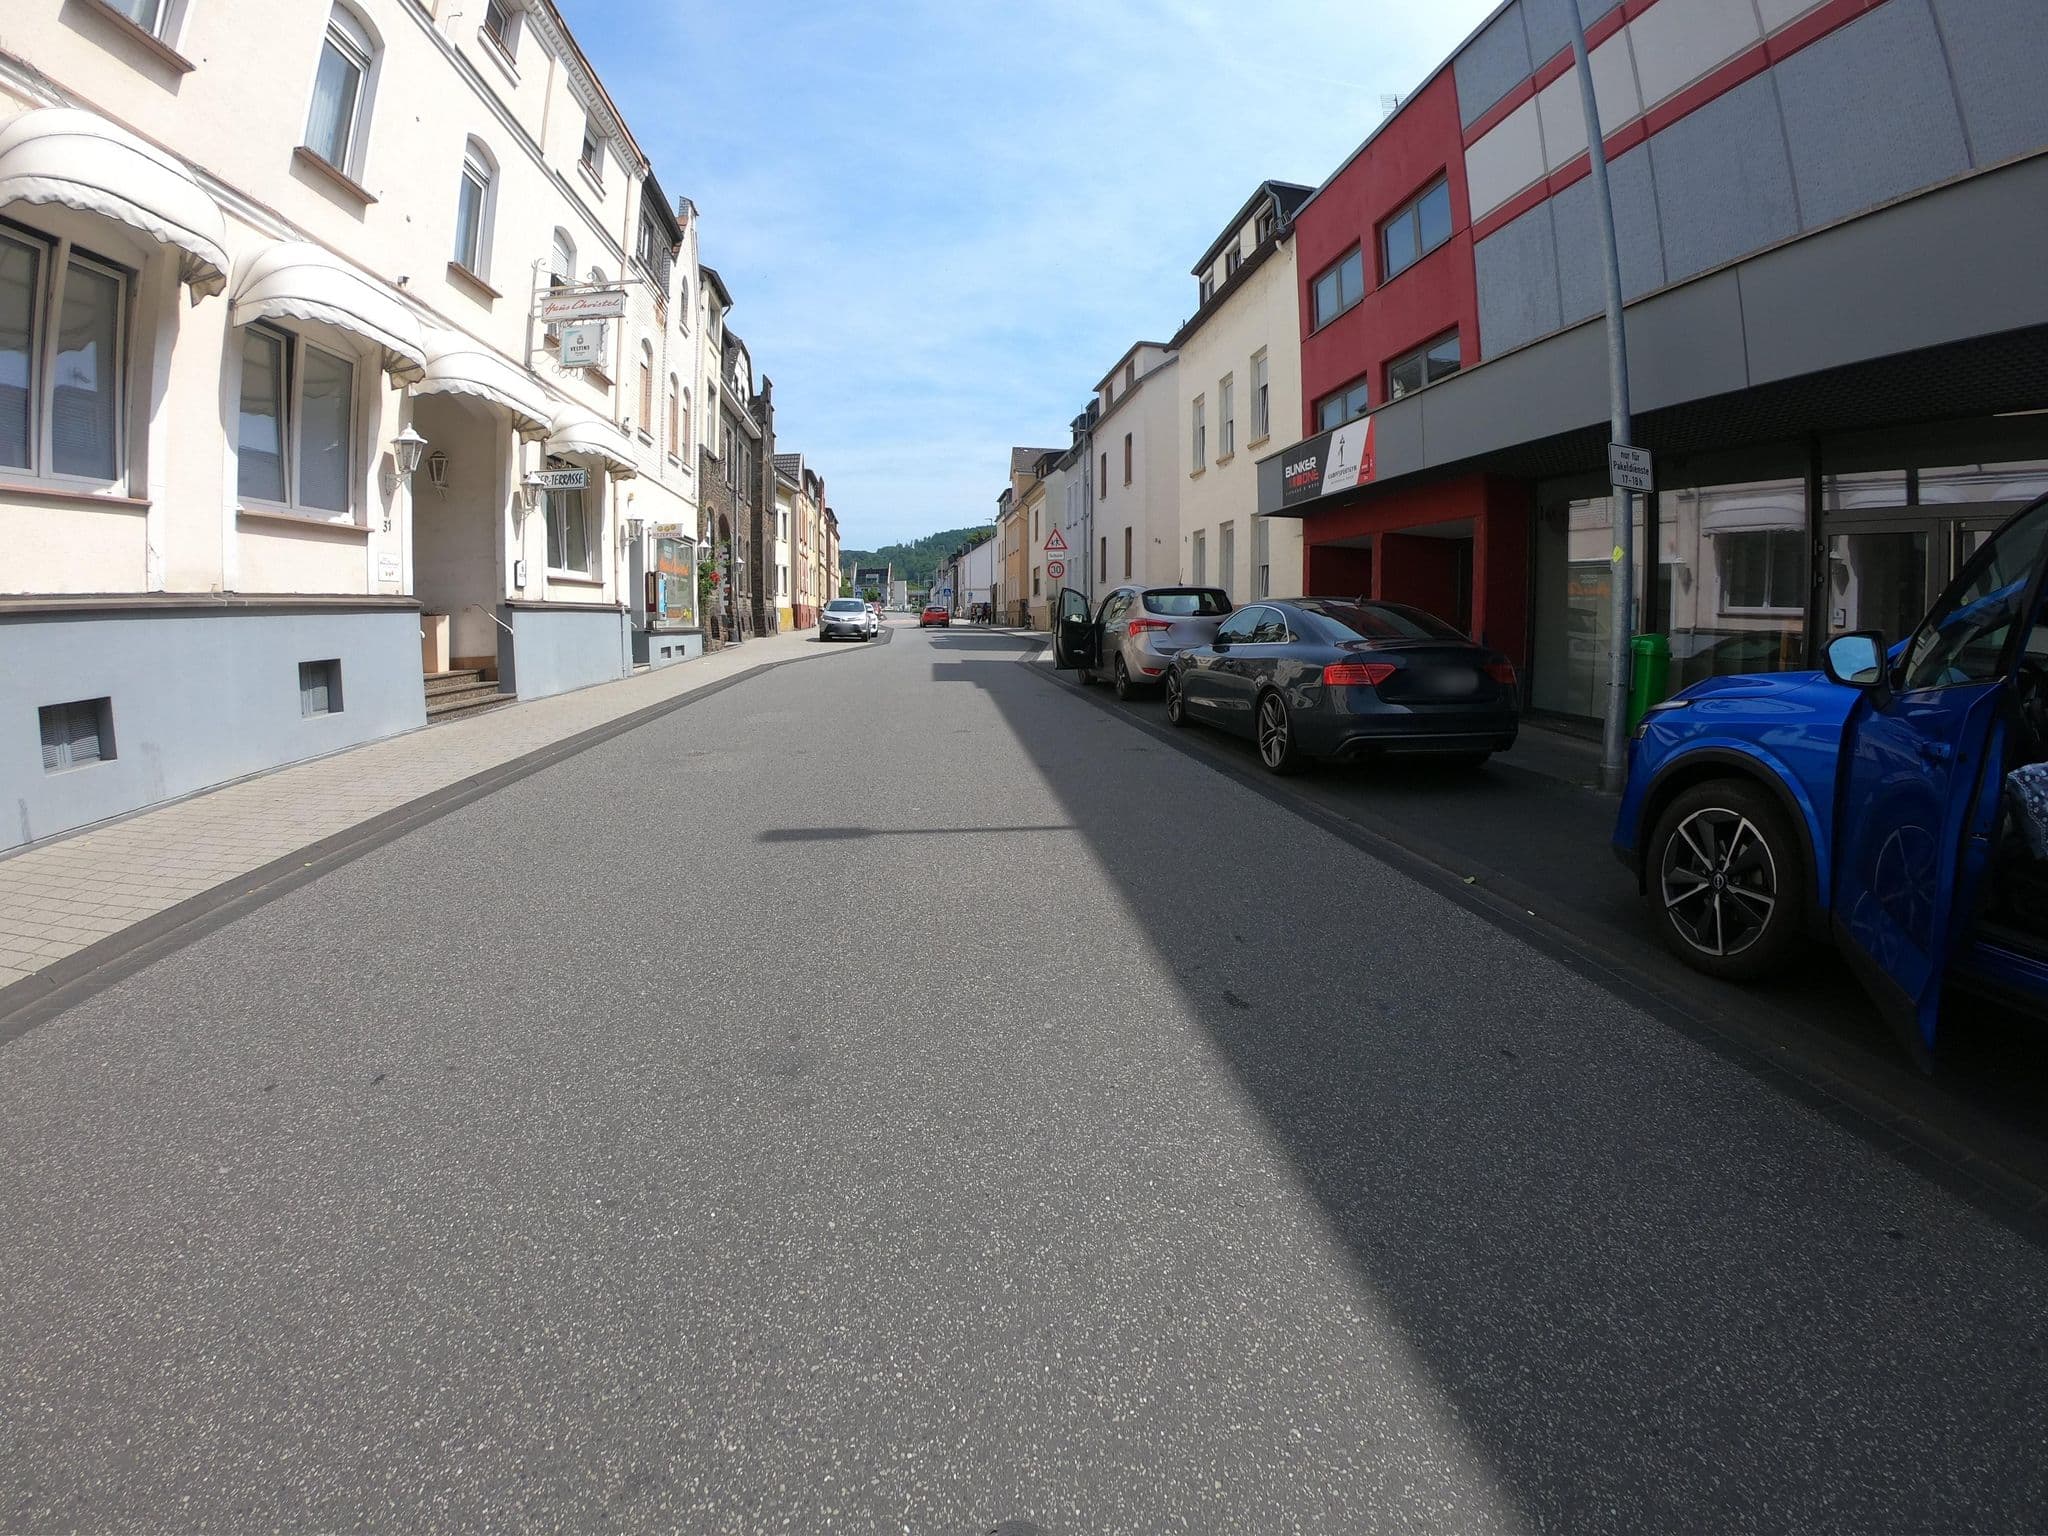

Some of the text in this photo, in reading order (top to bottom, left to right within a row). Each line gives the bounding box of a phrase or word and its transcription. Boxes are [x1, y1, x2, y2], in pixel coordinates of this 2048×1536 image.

[545, 299, 619, 314] Haus Christel
[1285, 456, 1317, 478] BUNKER
[382, 519, 392, 533] 31
[1051, 565, 1061, 574] 30
